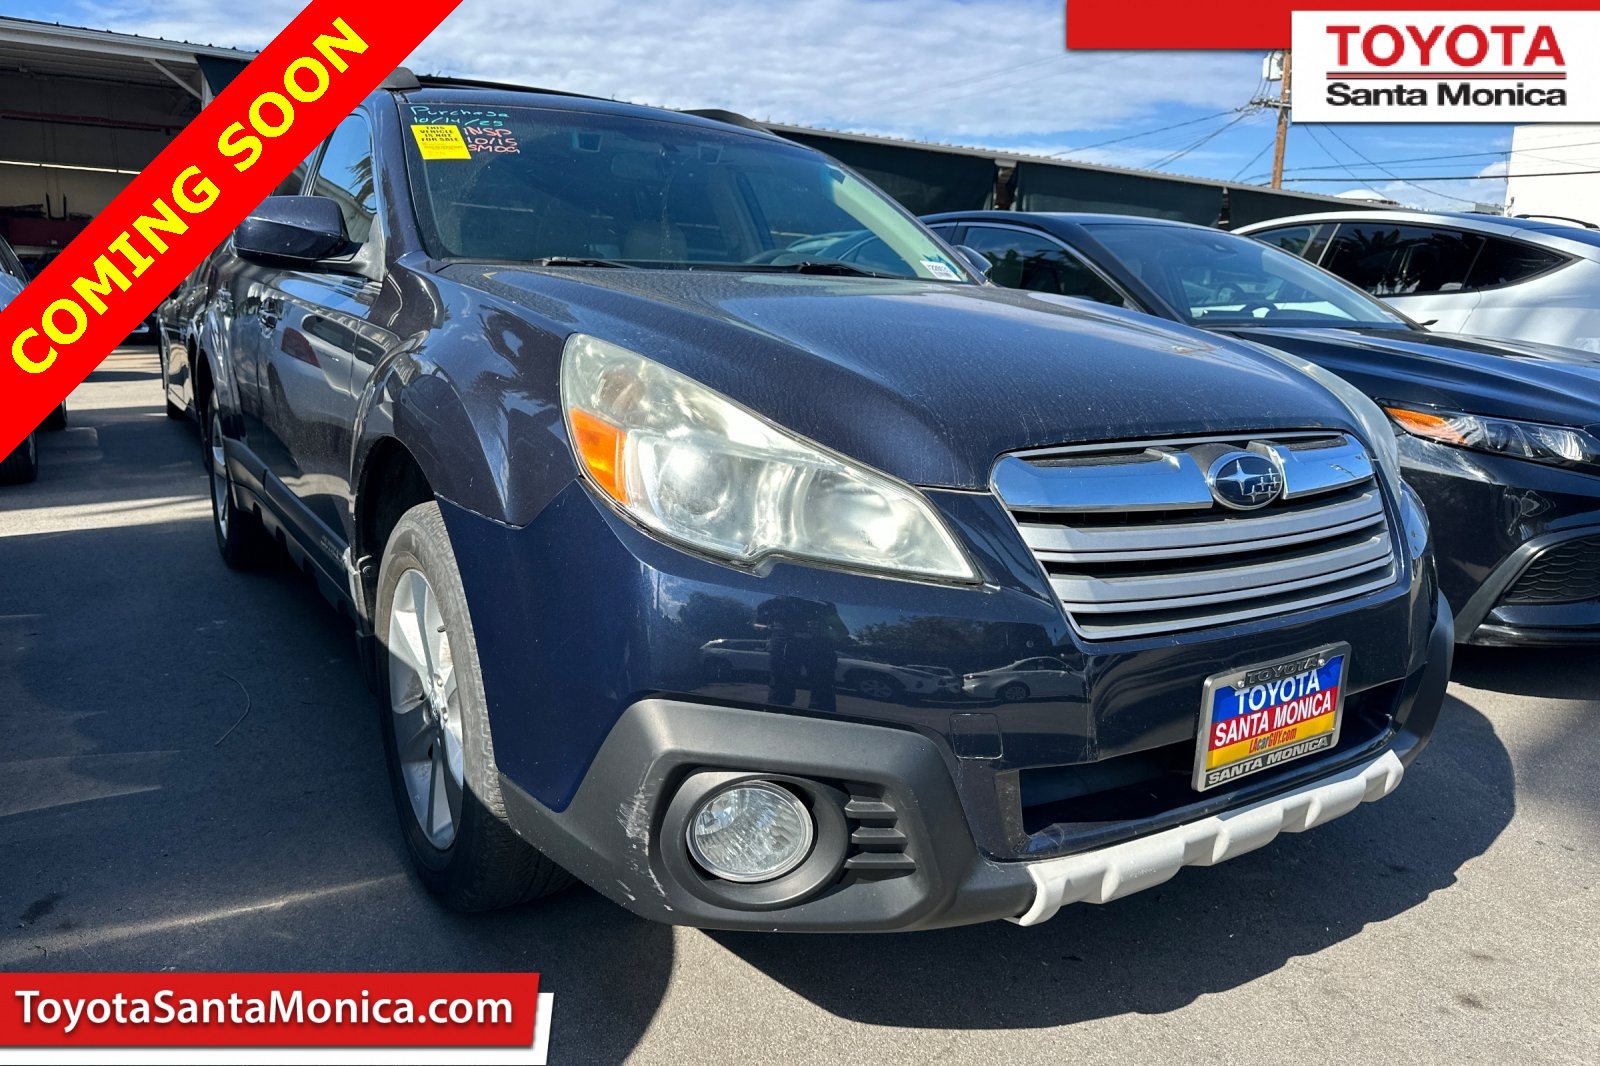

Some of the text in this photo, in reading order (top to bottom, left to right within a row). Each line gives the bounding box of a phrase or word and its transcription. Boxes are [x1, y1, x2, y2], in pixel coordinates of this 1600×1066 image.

[463, 126, 512, 138] INSP
[1247, 656, 1318, 684] TOYOTA
[1234, 669, 1320, 715] TOYOTA
[1214, 690, 1331, 747] SANTA MONICA
[1249, 727, 1298, 754] LAcarGUY.com
[1208, 736, 1329, 785] SANTA MONICA
